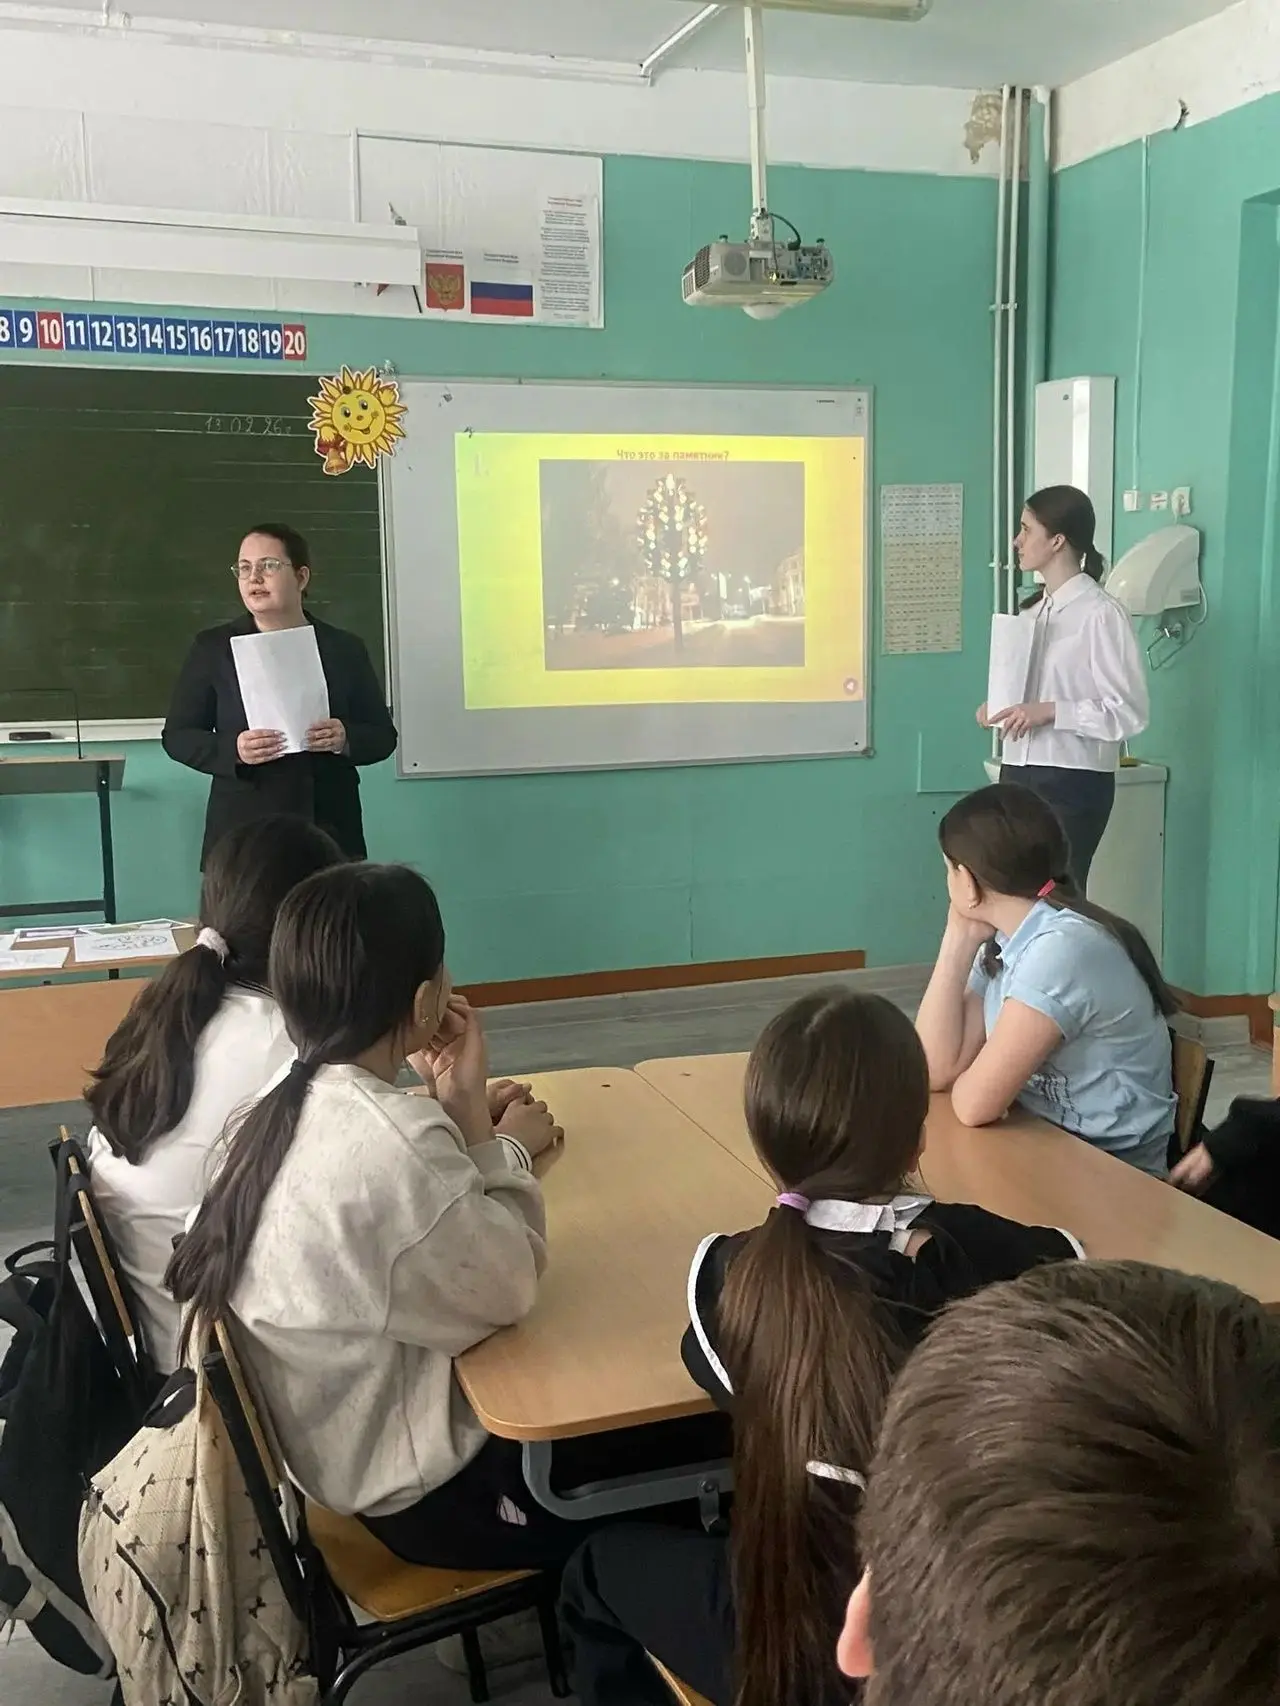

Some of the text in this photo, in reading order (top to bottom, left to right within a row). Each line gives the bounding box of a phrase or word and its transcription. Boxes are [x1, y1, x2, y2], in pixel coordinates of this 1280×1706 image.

[0, 316, 305, 355] 8 9 10 11 12 13 14 15 16 17 18 19 20
[617, 448, 636, 460] Что
[638, 450, 656, 460] это
[673, 450, 730, 463] памятник?
